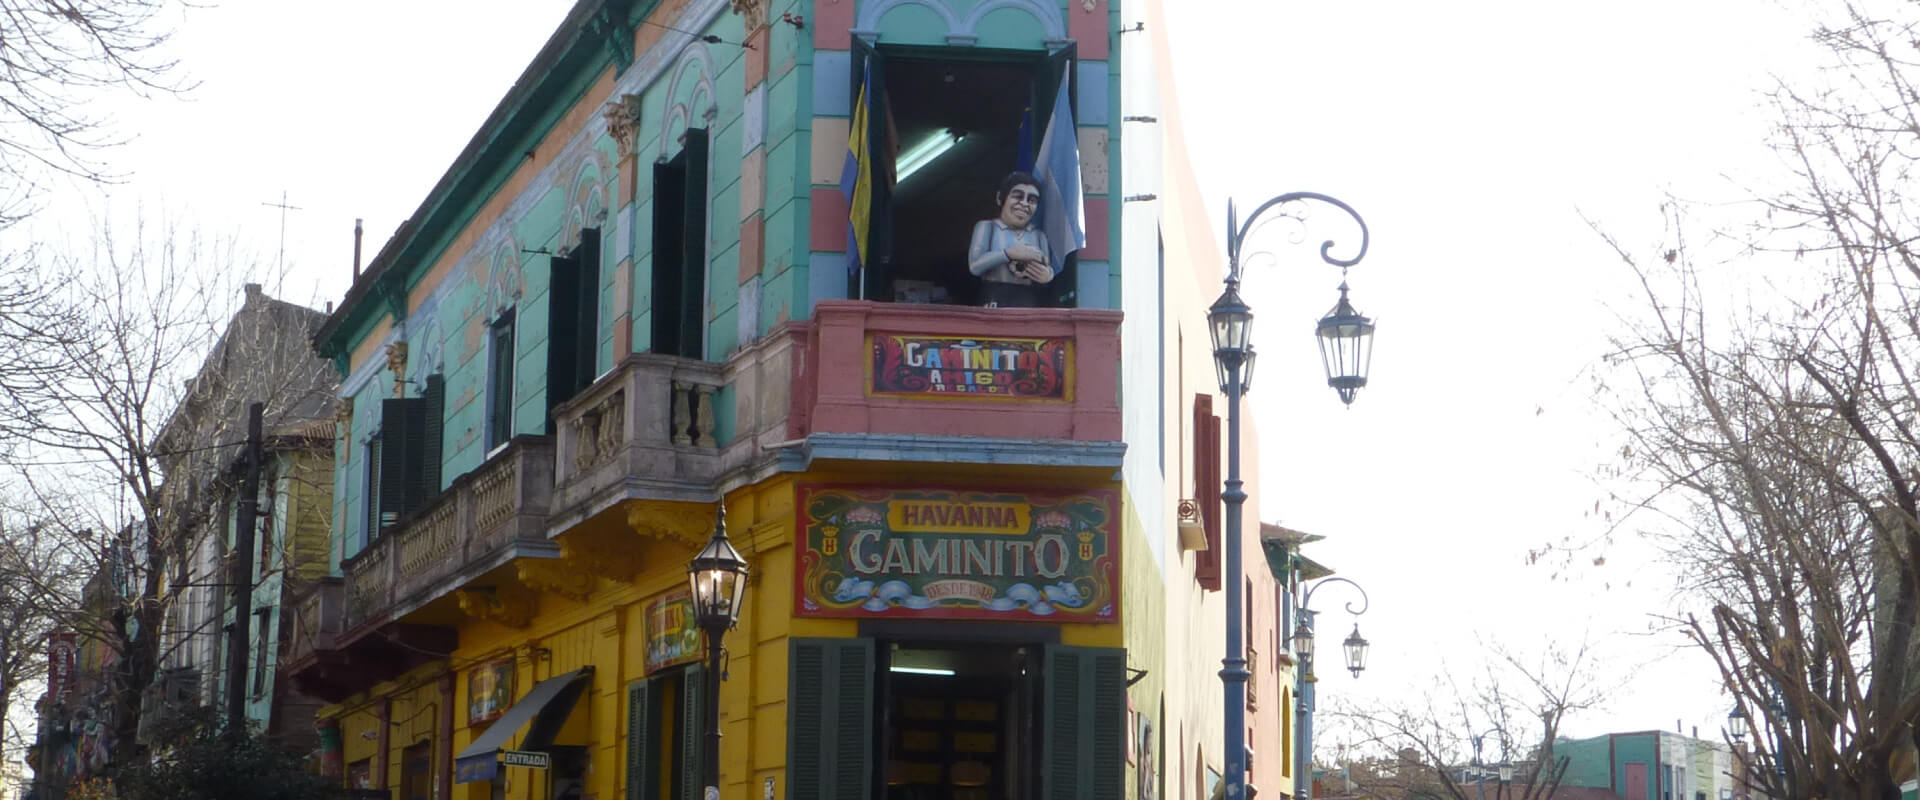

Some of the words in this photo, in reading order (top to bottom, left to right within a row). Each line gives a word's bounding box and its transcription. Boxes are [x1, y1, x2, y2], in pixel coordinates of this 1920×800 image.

[931, 369, 1012, 385] AMIGO
[903, 505, 1019, 528] HAVANNA
[825, 540, 834, 553] H
[850, 529, 1070, 578] CAMINITO
[1082, 545, 1091, 558] H
[928, 582, 968, 599] DESDE
[506, 753, 546, 766] ENTRADA
